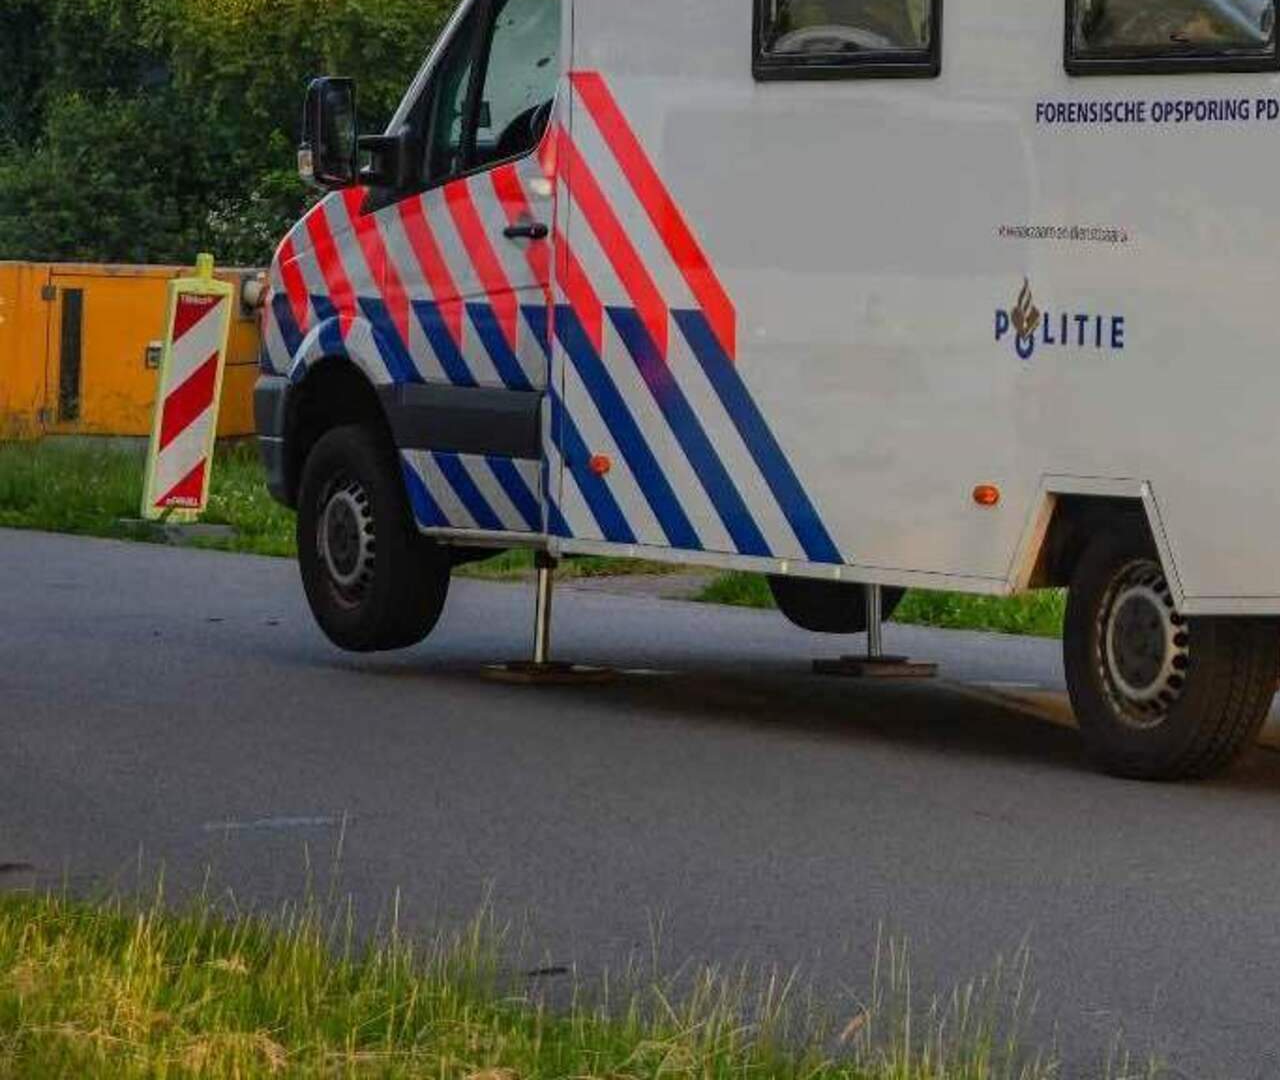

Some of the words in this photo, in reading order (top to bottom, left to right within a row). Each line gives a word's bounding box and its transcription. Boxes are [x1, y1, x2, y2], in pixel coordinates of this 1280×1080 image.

[1035, 101, 1146, 123] FORENSISCHE
[1151, 98, 1250, 122] OPSPORING
[1255, 98, 1280, 121] PD
[995, 308, 1124, 359] POLITIE
